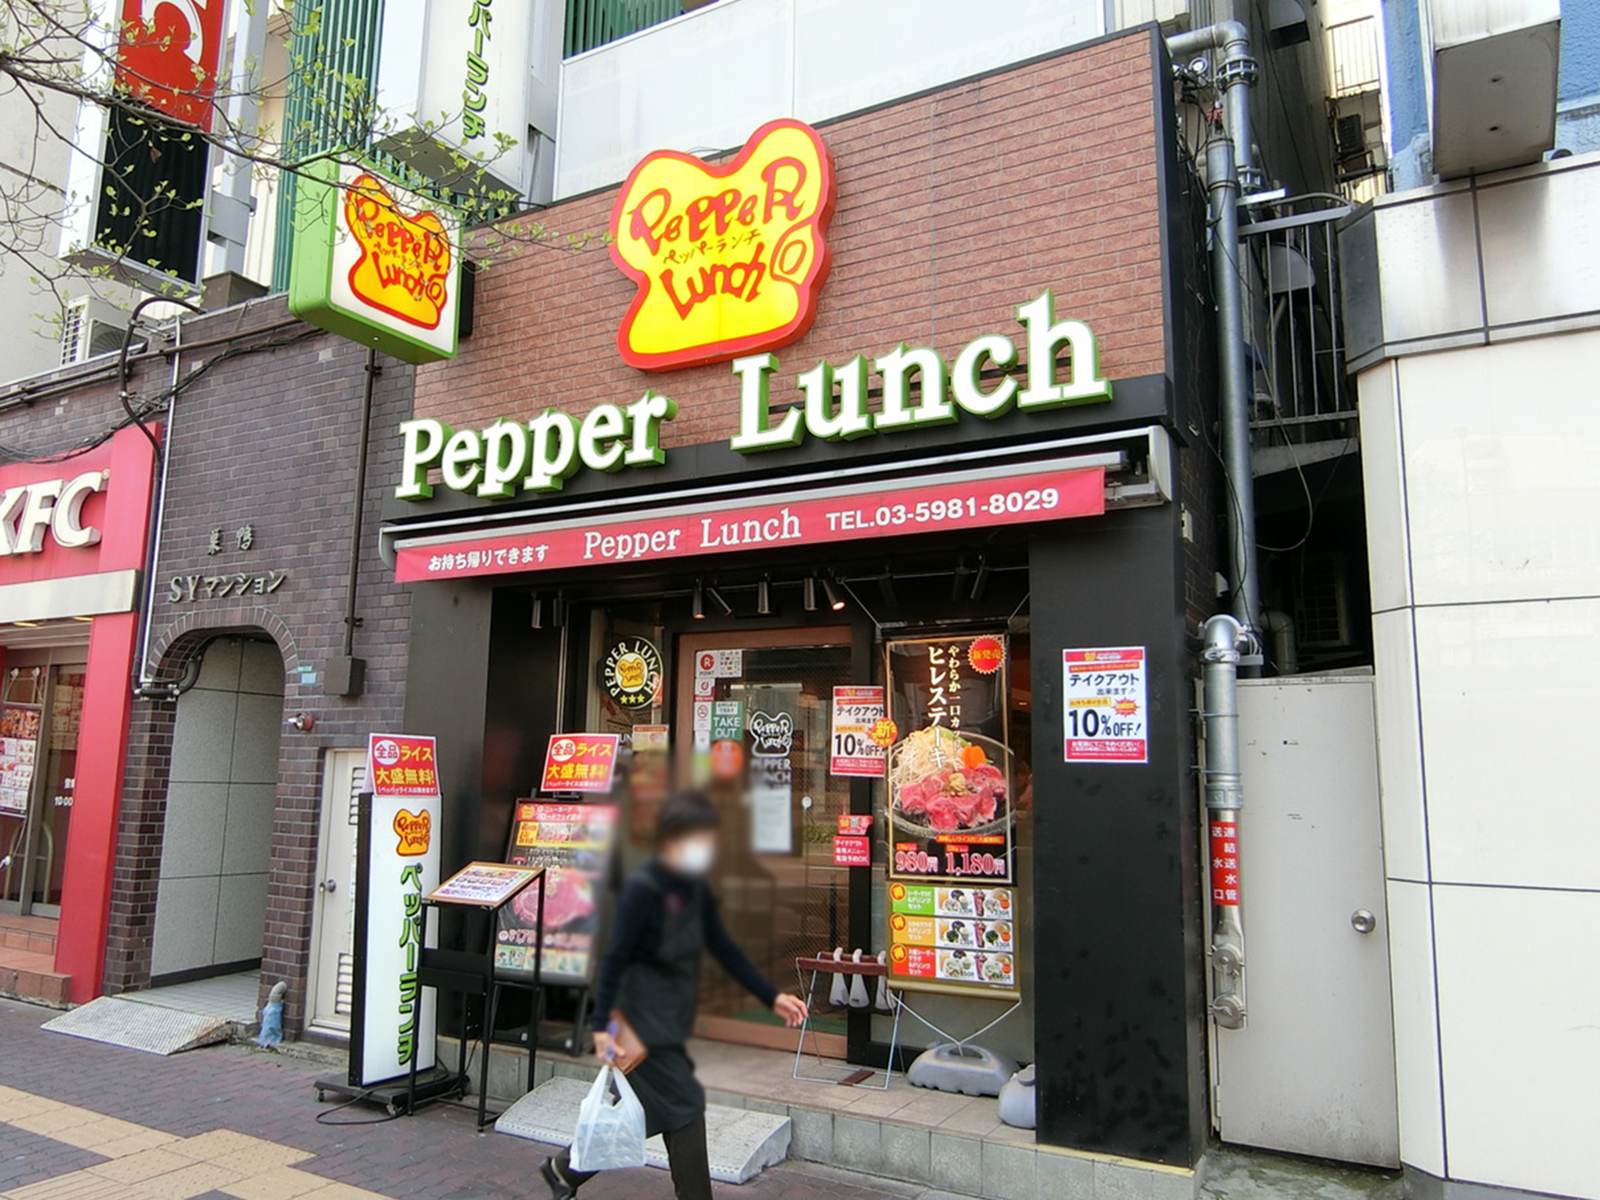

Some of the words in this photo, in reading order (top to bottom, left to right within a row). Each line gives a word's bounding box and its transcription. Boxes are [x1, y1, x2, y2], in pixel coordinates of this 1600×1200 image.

[461, 0, 493, 139] パーランチ
[395, 390, 677, 500] Pepper
[730, 289, 1112, 454] Lunch
[428, 544, 549, 571] お持ち帰りできます
[583, 528, 681, 560] Pepper
[700, 506, 802, 547] Lunch
[826, 487, 1059, 531] TEL.03-5981-8029
[604, 642, 629, 697] PEPPER
[634, 641, 660, 695] LUNCH
[1069, 673, 1139, 687] テイクアウト
[713, 717, 740, 727] TAKE
[927, 646, 947, 769] ヒレステーキ
[376, 744, 398, 759] 全品
[401, 746, 433, 761] ライス
[553, 743, 574, 756] 全品
[577, 743, 612, 757] ライス
[715, 728, 737, 738] OUT
[376, 767, 435, 785] 大盛無料!
[946, 853, 1005, 876] 1,180円
[1212, 827, 1224, 899] 送水口
[1223, 827, 1238, 901] 連結送水管
